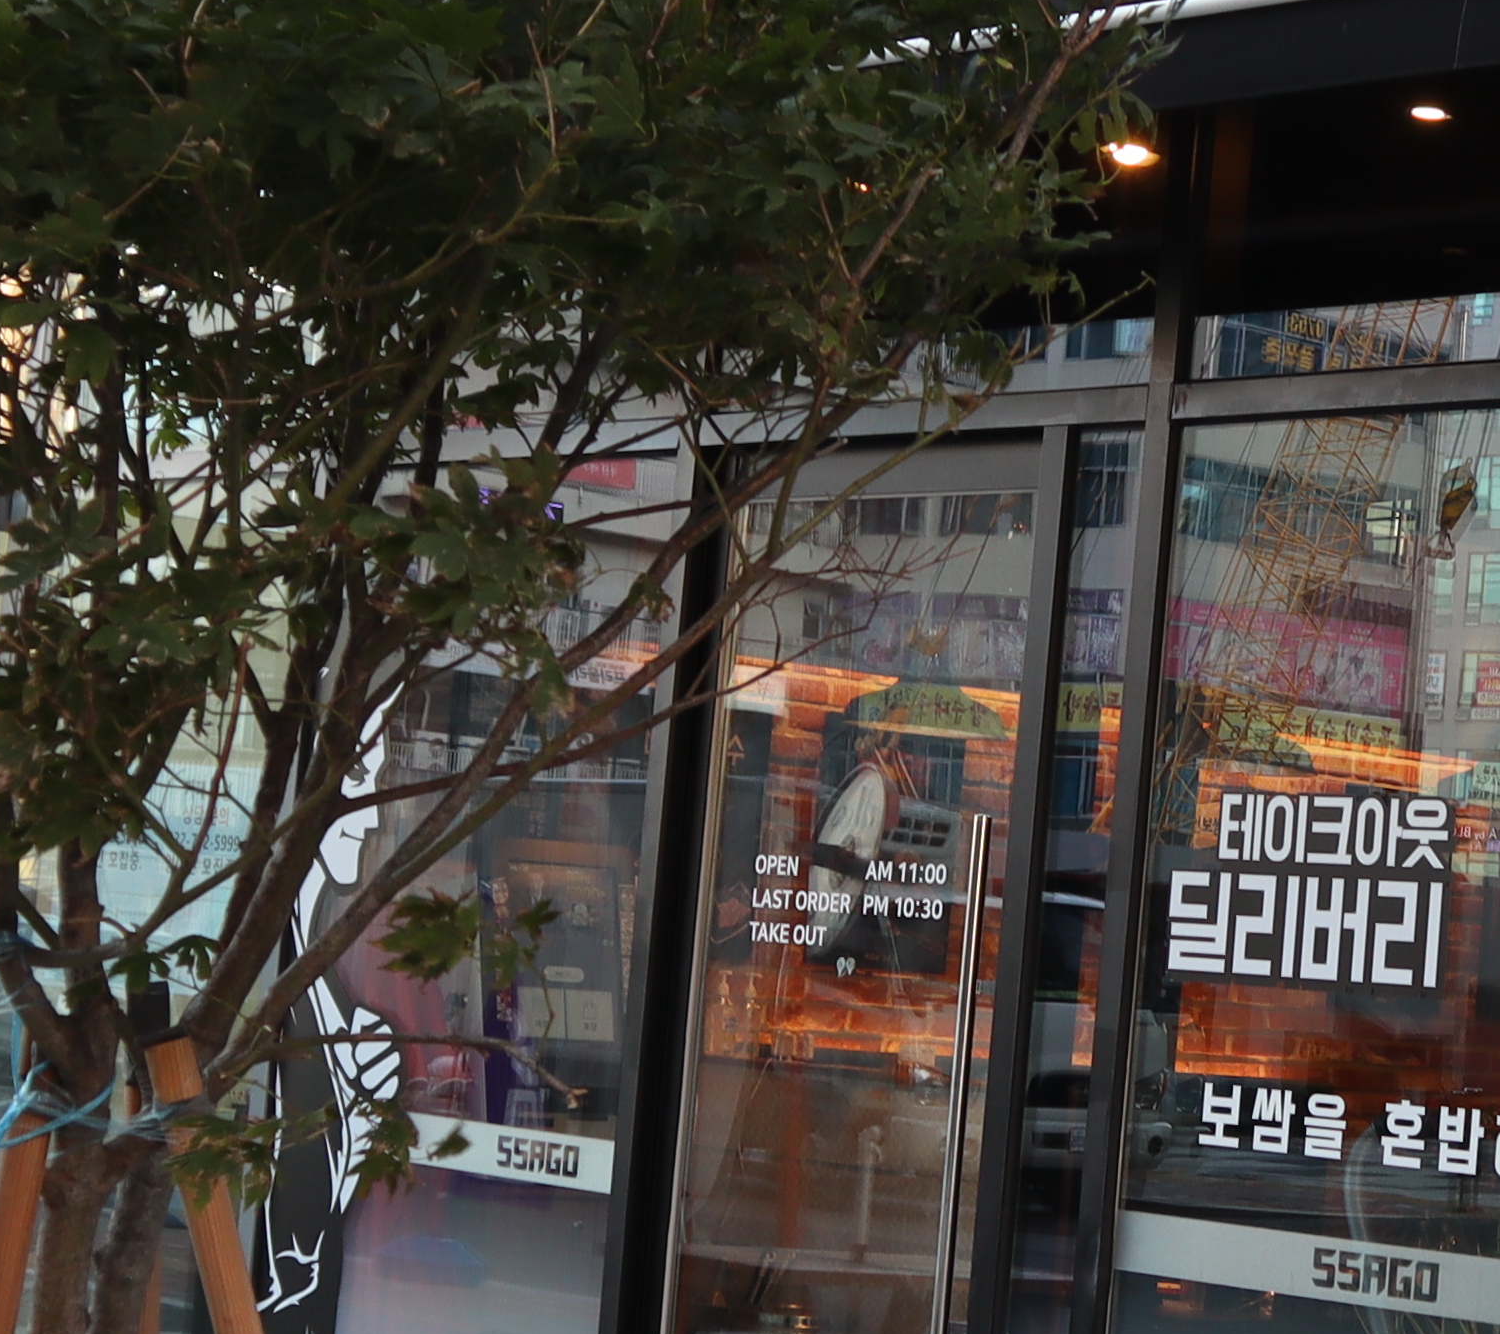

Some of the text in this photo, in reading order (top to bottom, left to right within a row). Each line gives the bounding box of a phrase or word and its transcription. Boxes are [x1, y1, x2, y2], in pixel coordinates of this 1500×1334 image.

[1217, 793, 1451, 870] 테이크아웃
[754, 854, 948, 885] OPEN AM 11:00
[752, 887, 944, 920] LAST ORDER PM 10:30
[749, 920, 828, 947] TAKE OUT
[1168, 870, 1445, 989] 딜리버리
[1198, 1081, 1348, 1161] 보쌈을
[496, 1134, 580, 1179] SSAGO
[1311, 1247, 1440, 1303] SSAGO
